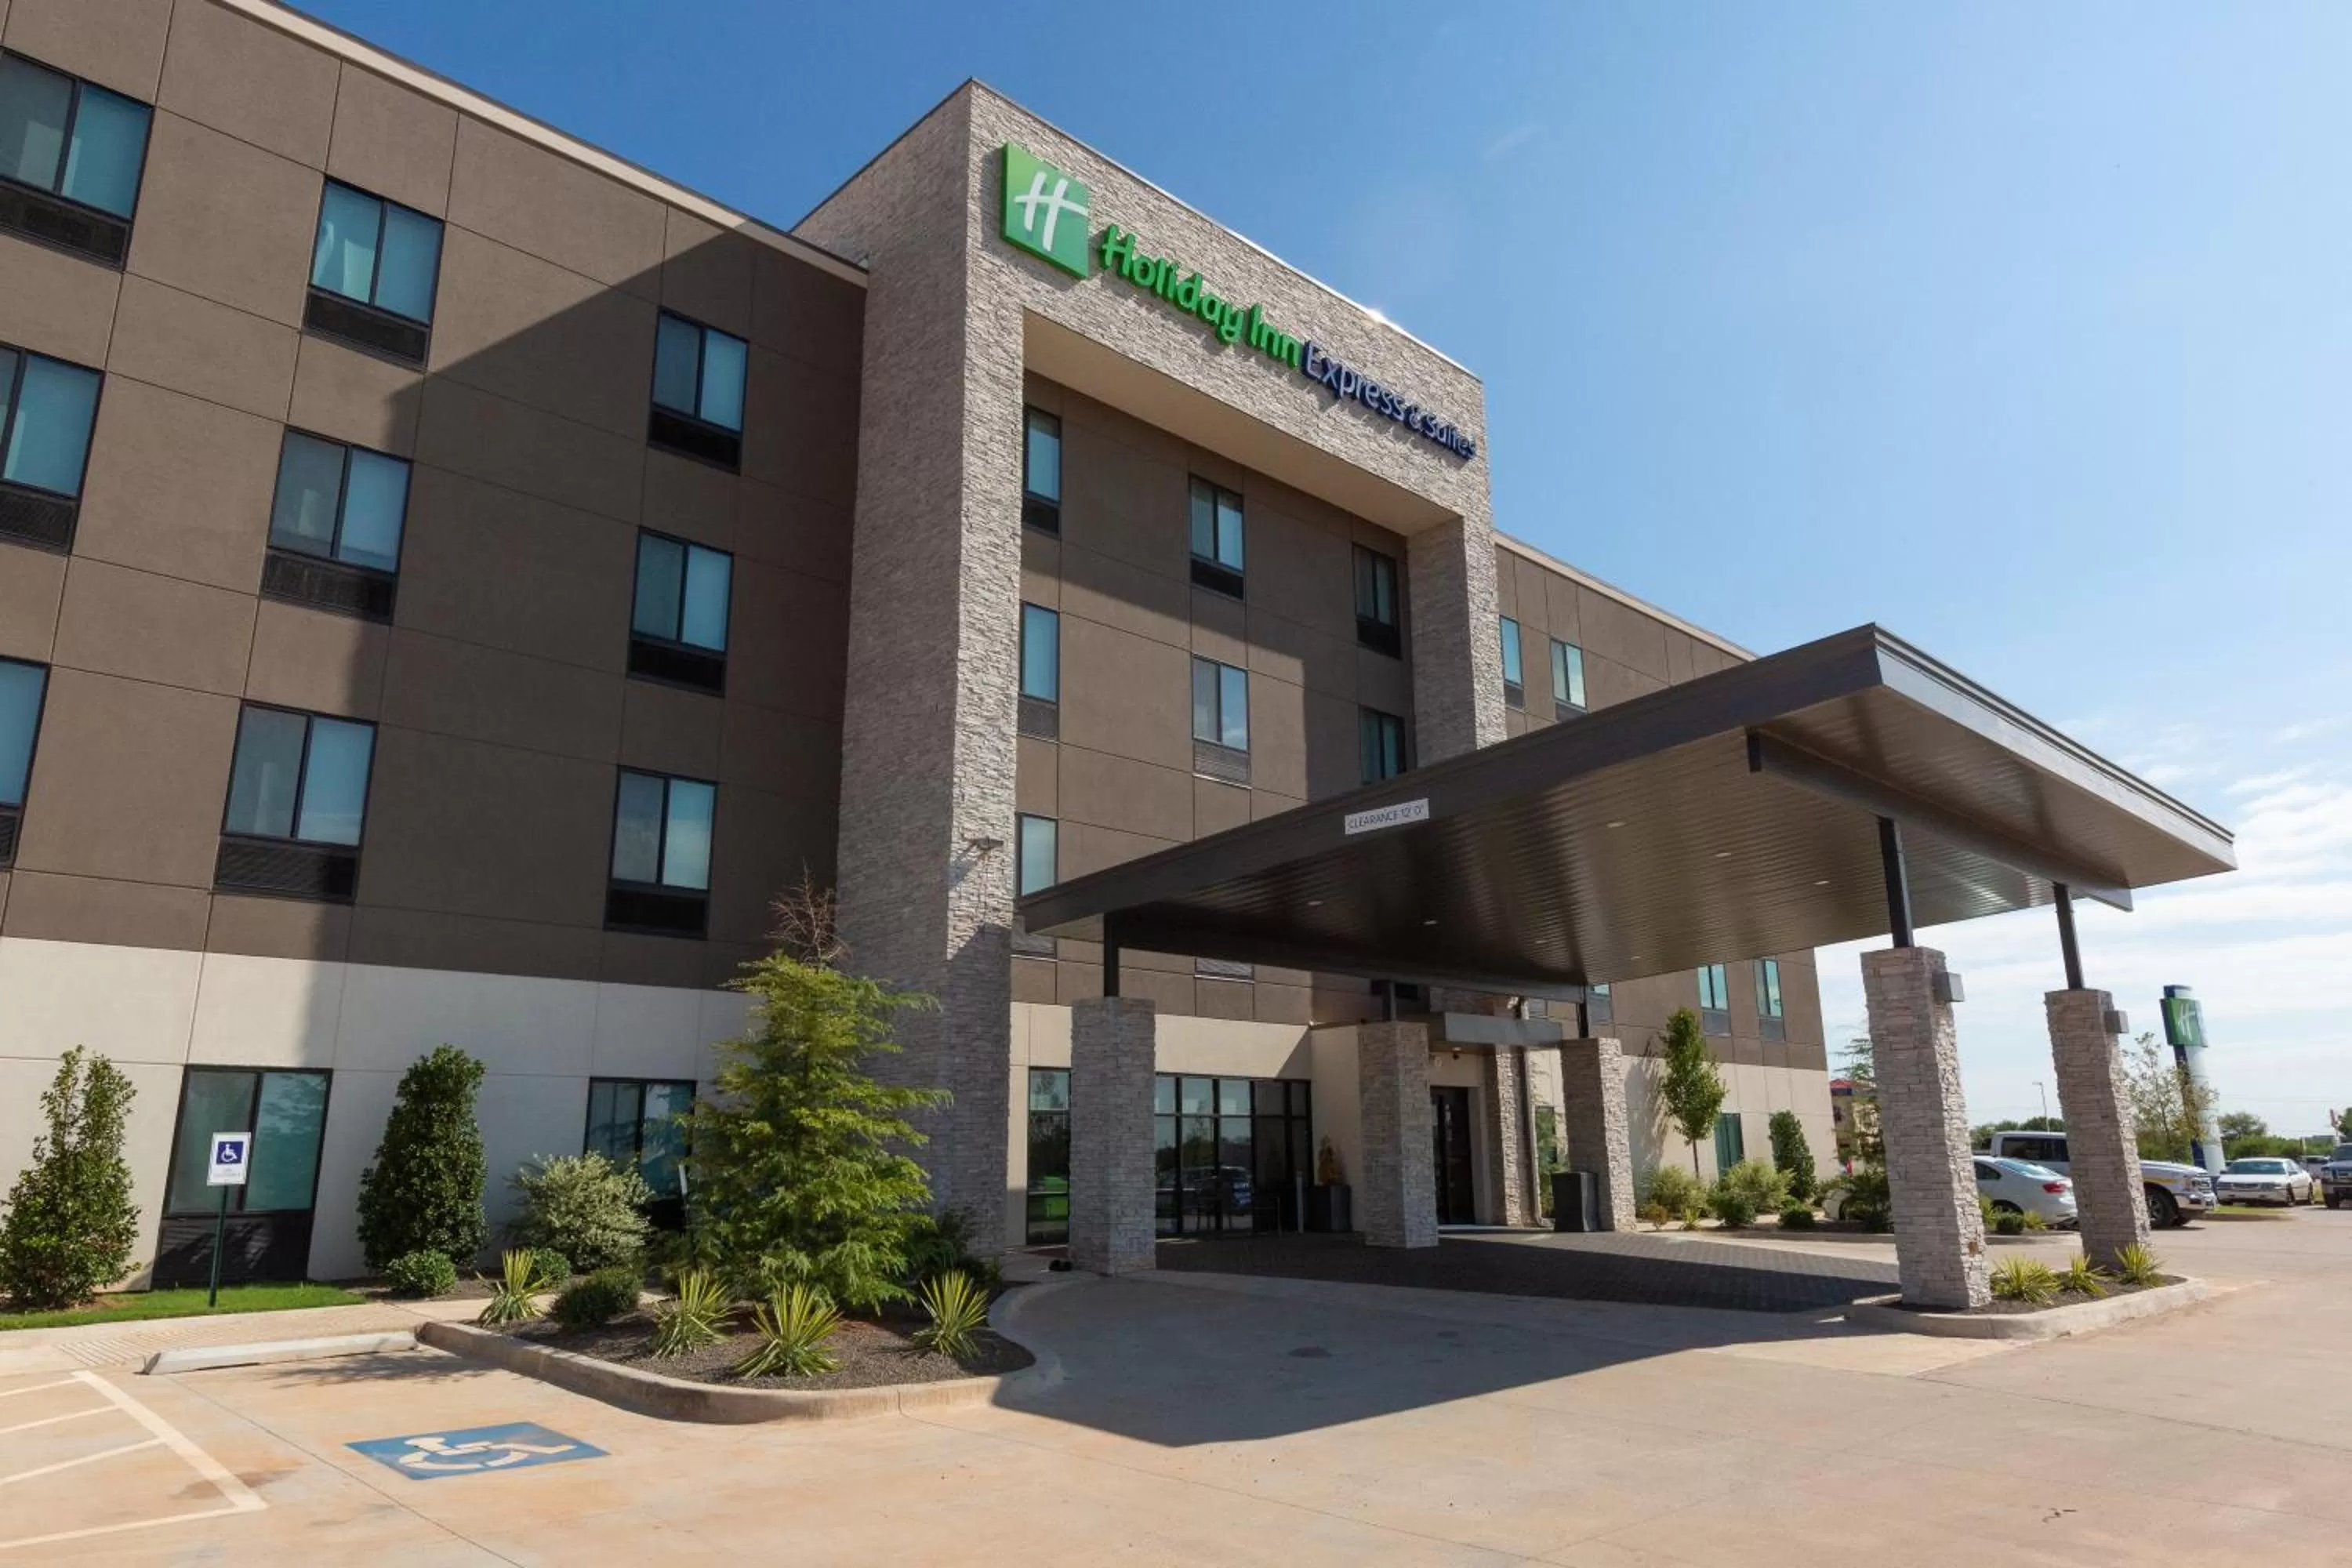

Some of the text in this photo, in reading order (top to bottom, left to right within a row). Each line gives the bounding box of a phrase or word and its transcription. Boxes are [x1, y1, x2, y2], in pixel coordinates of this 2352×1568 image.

[1099, 223, 1245, 346] Holiday
[1247, 303, 1303, 370] Inn
[1301, 339, 1406, 423] Express
